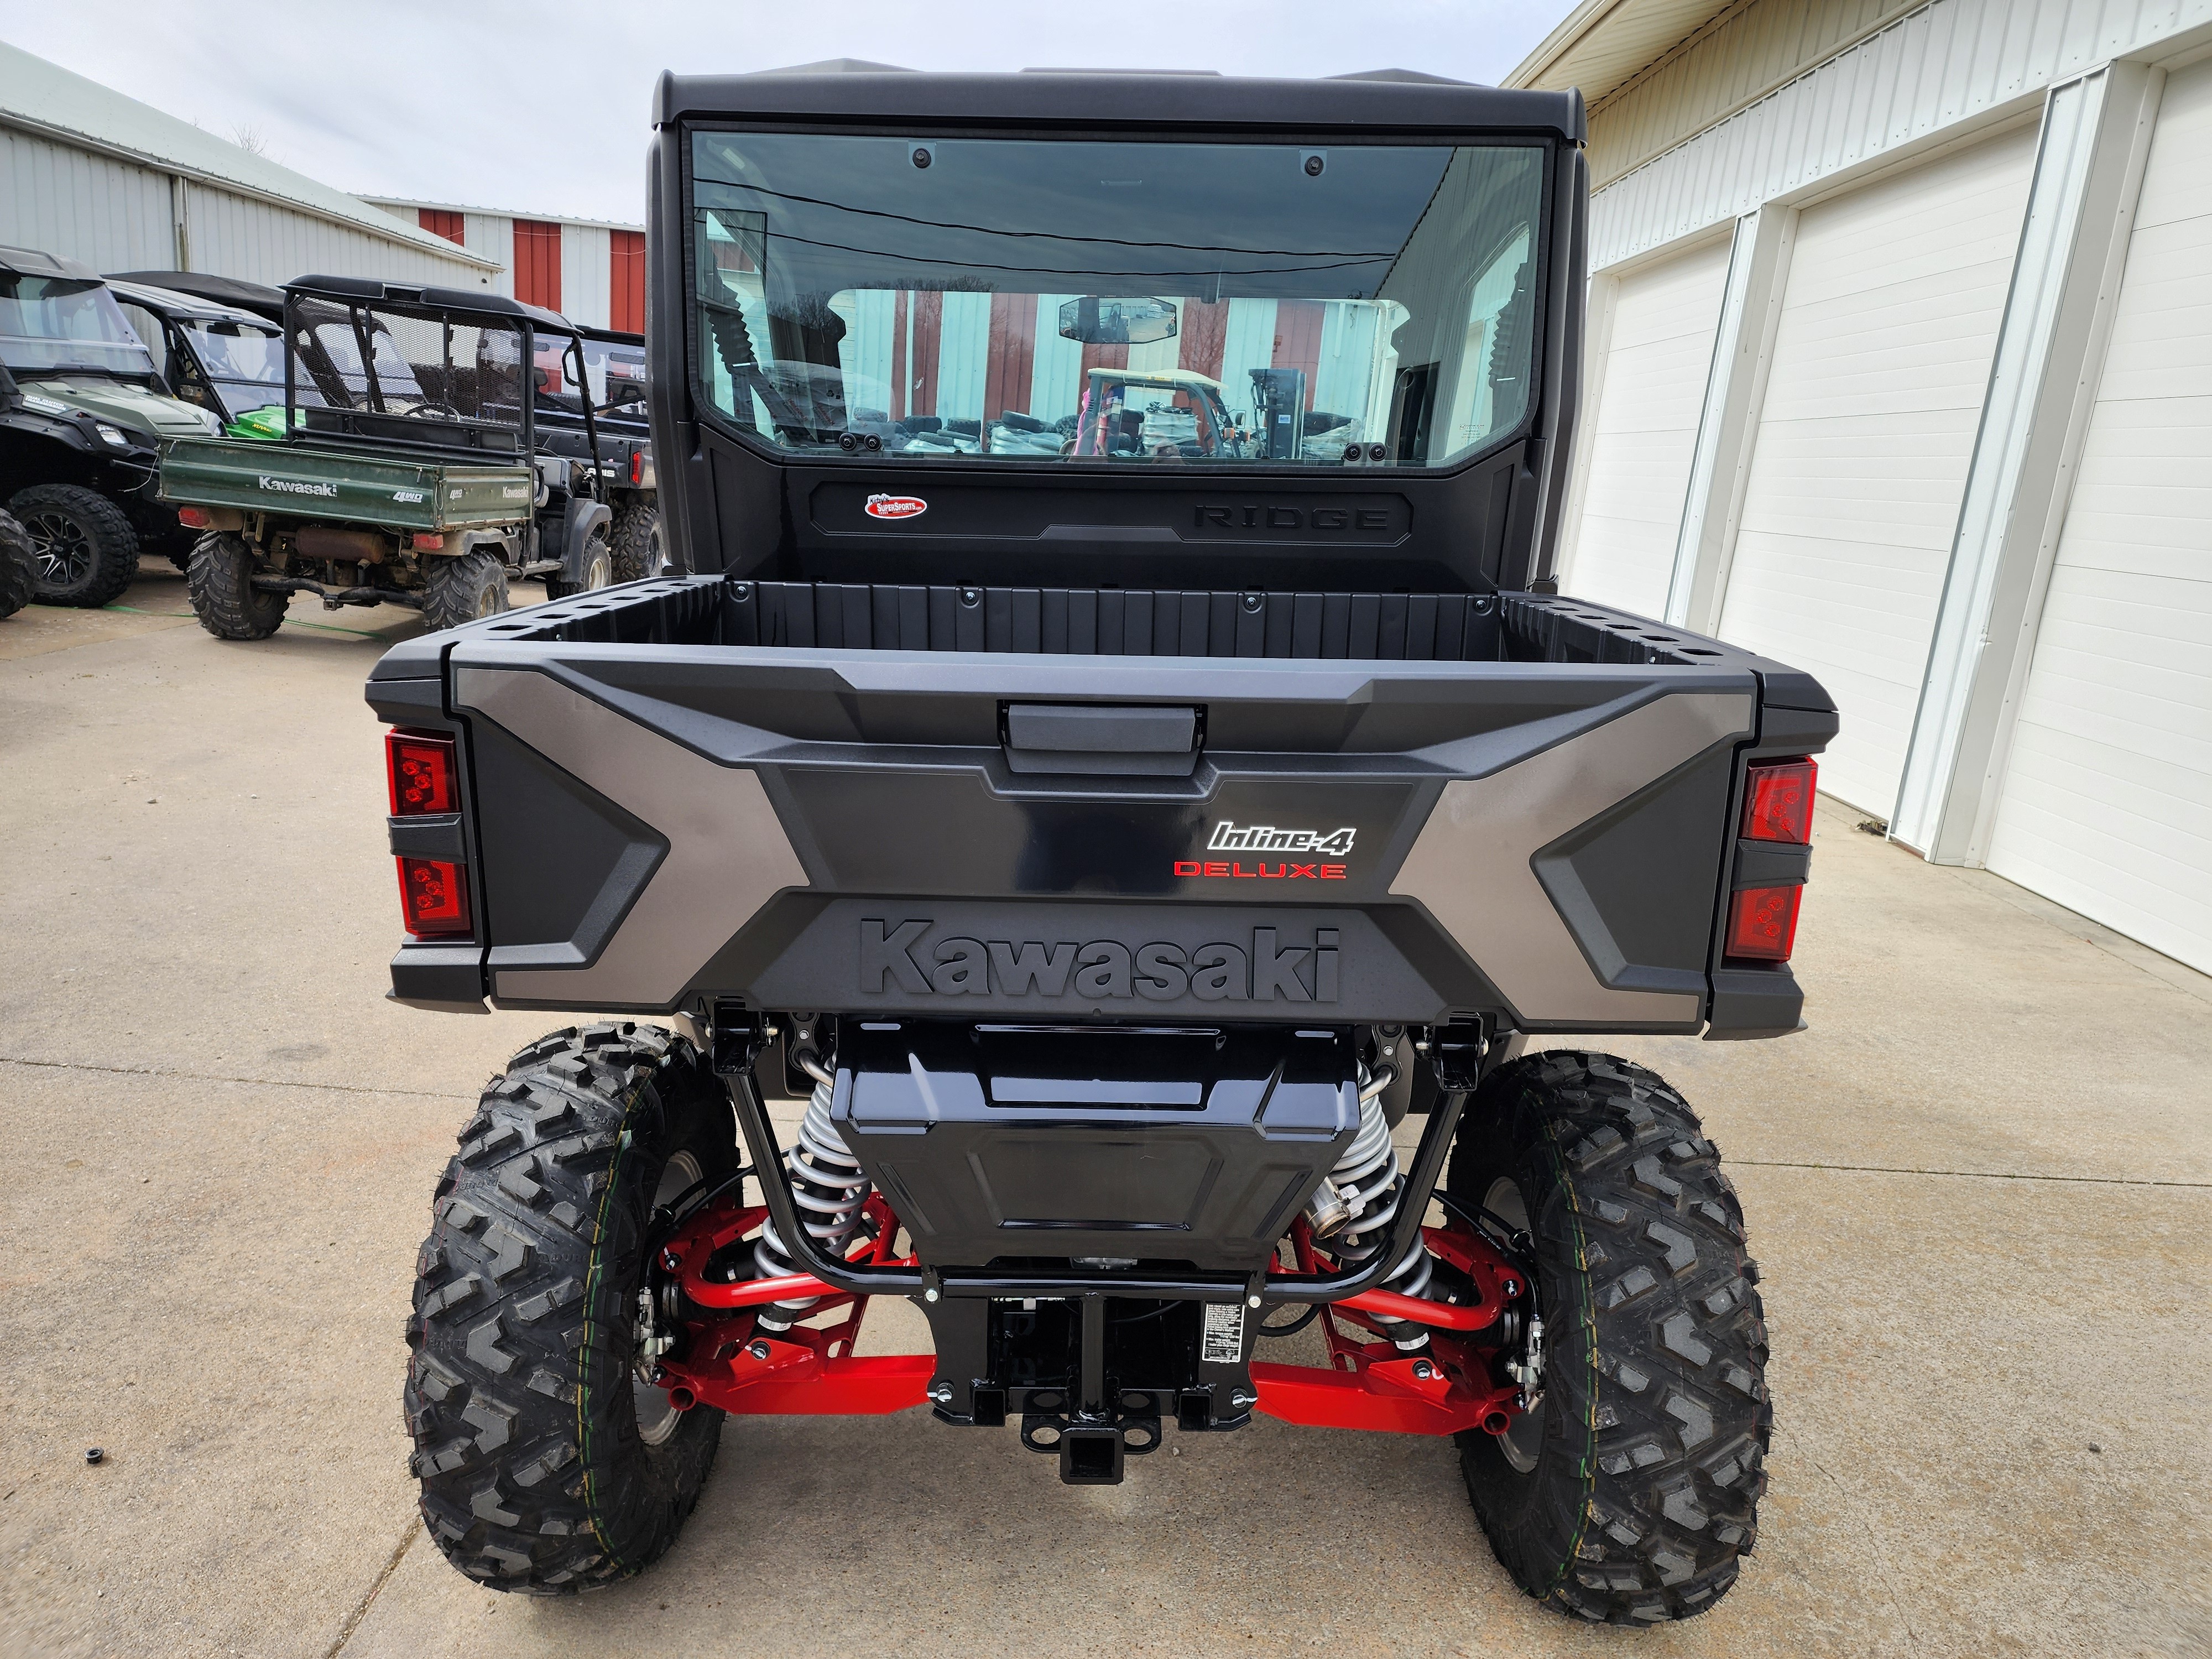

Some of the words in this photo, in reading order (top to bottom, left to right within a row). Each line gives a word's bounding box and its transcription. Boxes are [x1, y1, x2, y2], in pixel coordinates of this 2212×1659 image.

[259, 476, 337, 497] Kawasaki
[450, 489, 463, 500] 4WD
[503, 486, 529, 498] Kawasaki
[393, 491, 424, 503] 4WD
[870, 496, 889, 504] Kirby's
[1194, 505, 1389, 529] RIDGE
[1207, 822, 1357, 856] Inline-4
[1173, 860, 1347, 879] DELUXE
[860, 917, 1339, 1002] Kawasaki
